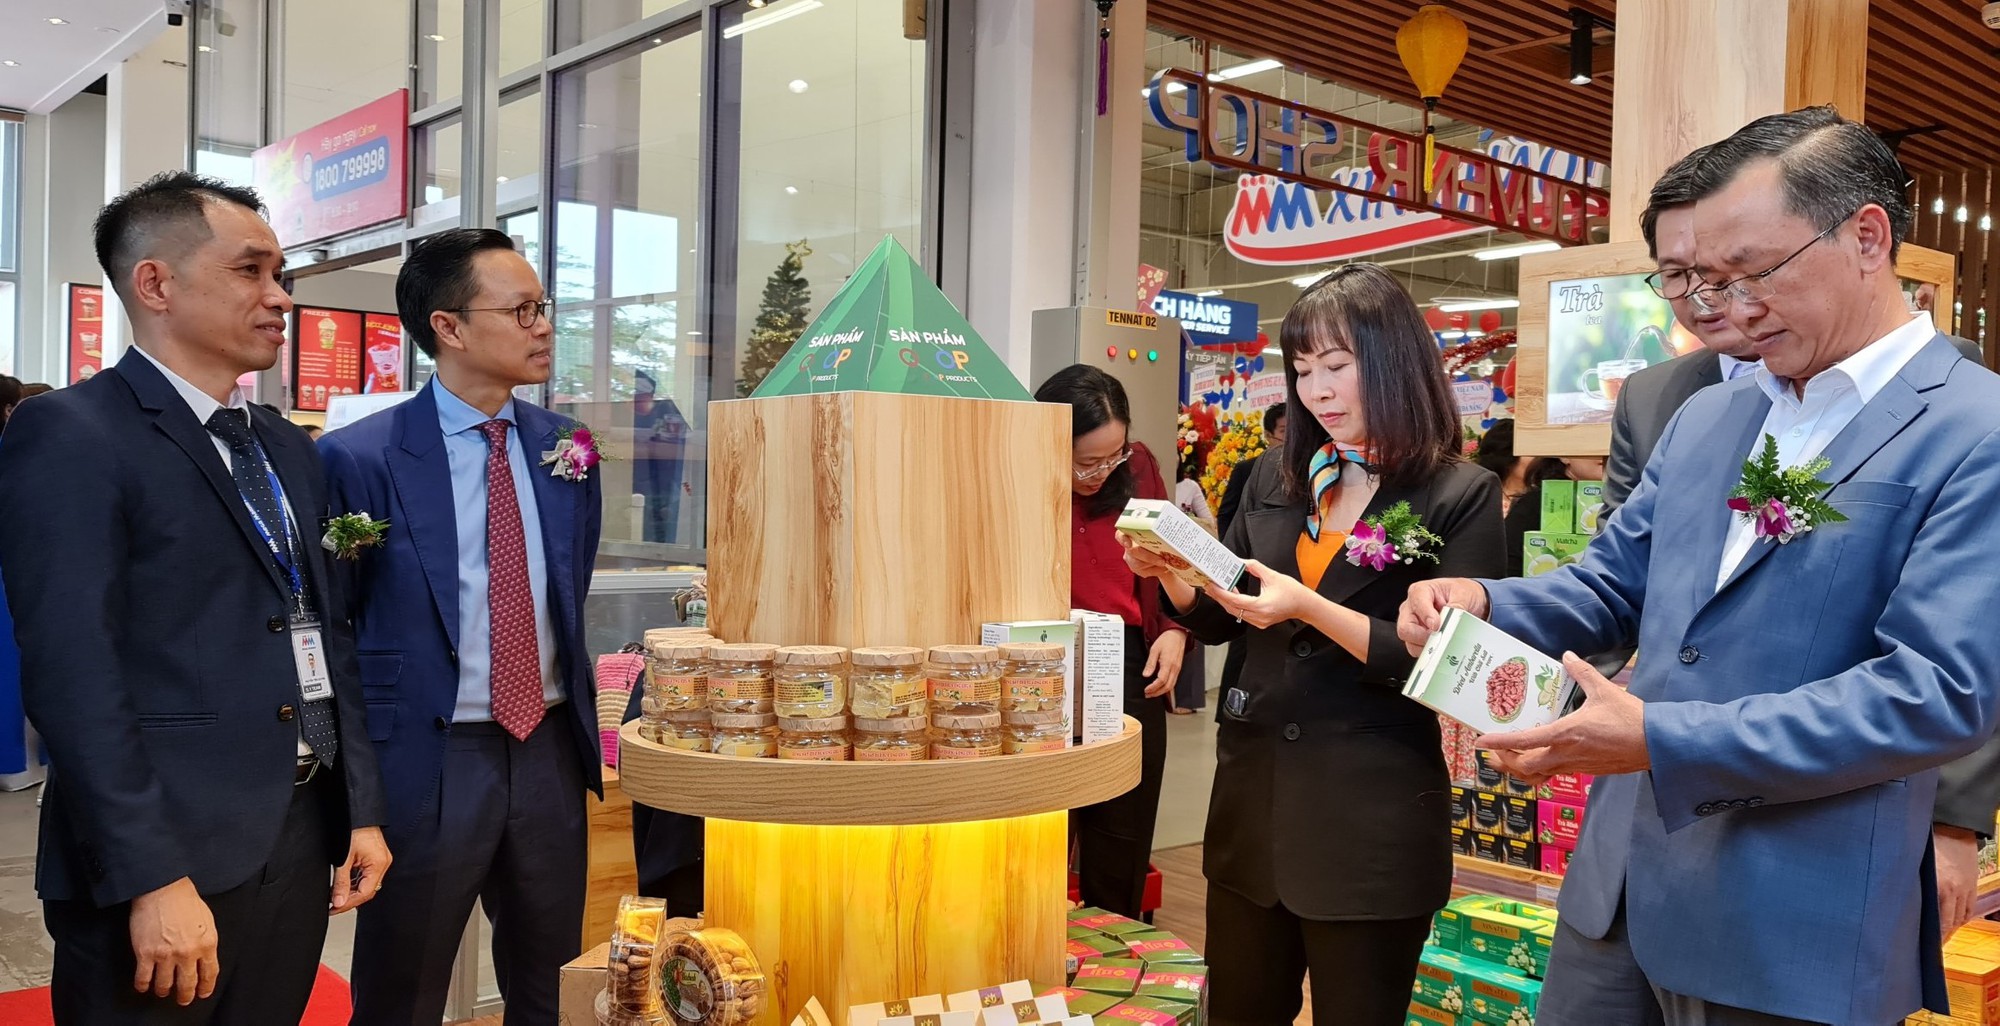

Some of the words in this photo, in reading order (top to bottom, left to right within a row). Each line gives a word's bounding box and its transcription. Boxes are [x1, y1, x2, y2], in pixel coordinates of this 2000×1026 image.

[315, 163, 339, 192] 1800
[342, 146, 385, 183] 799998
[1560, 284, 1603, 313] Trà
[1109, 311, 1144, 327] TENNAT
[1145, 316, 1157, 328] 02
[1180, 297, 1232, 325] HÀNG
[1196, 321, 1231, 335] SERVICE
[899, 347, 969, 370] OOP
[945, 374, 977, 382] PRODUCTS
[1453, 674, 1466, 695] Dried
